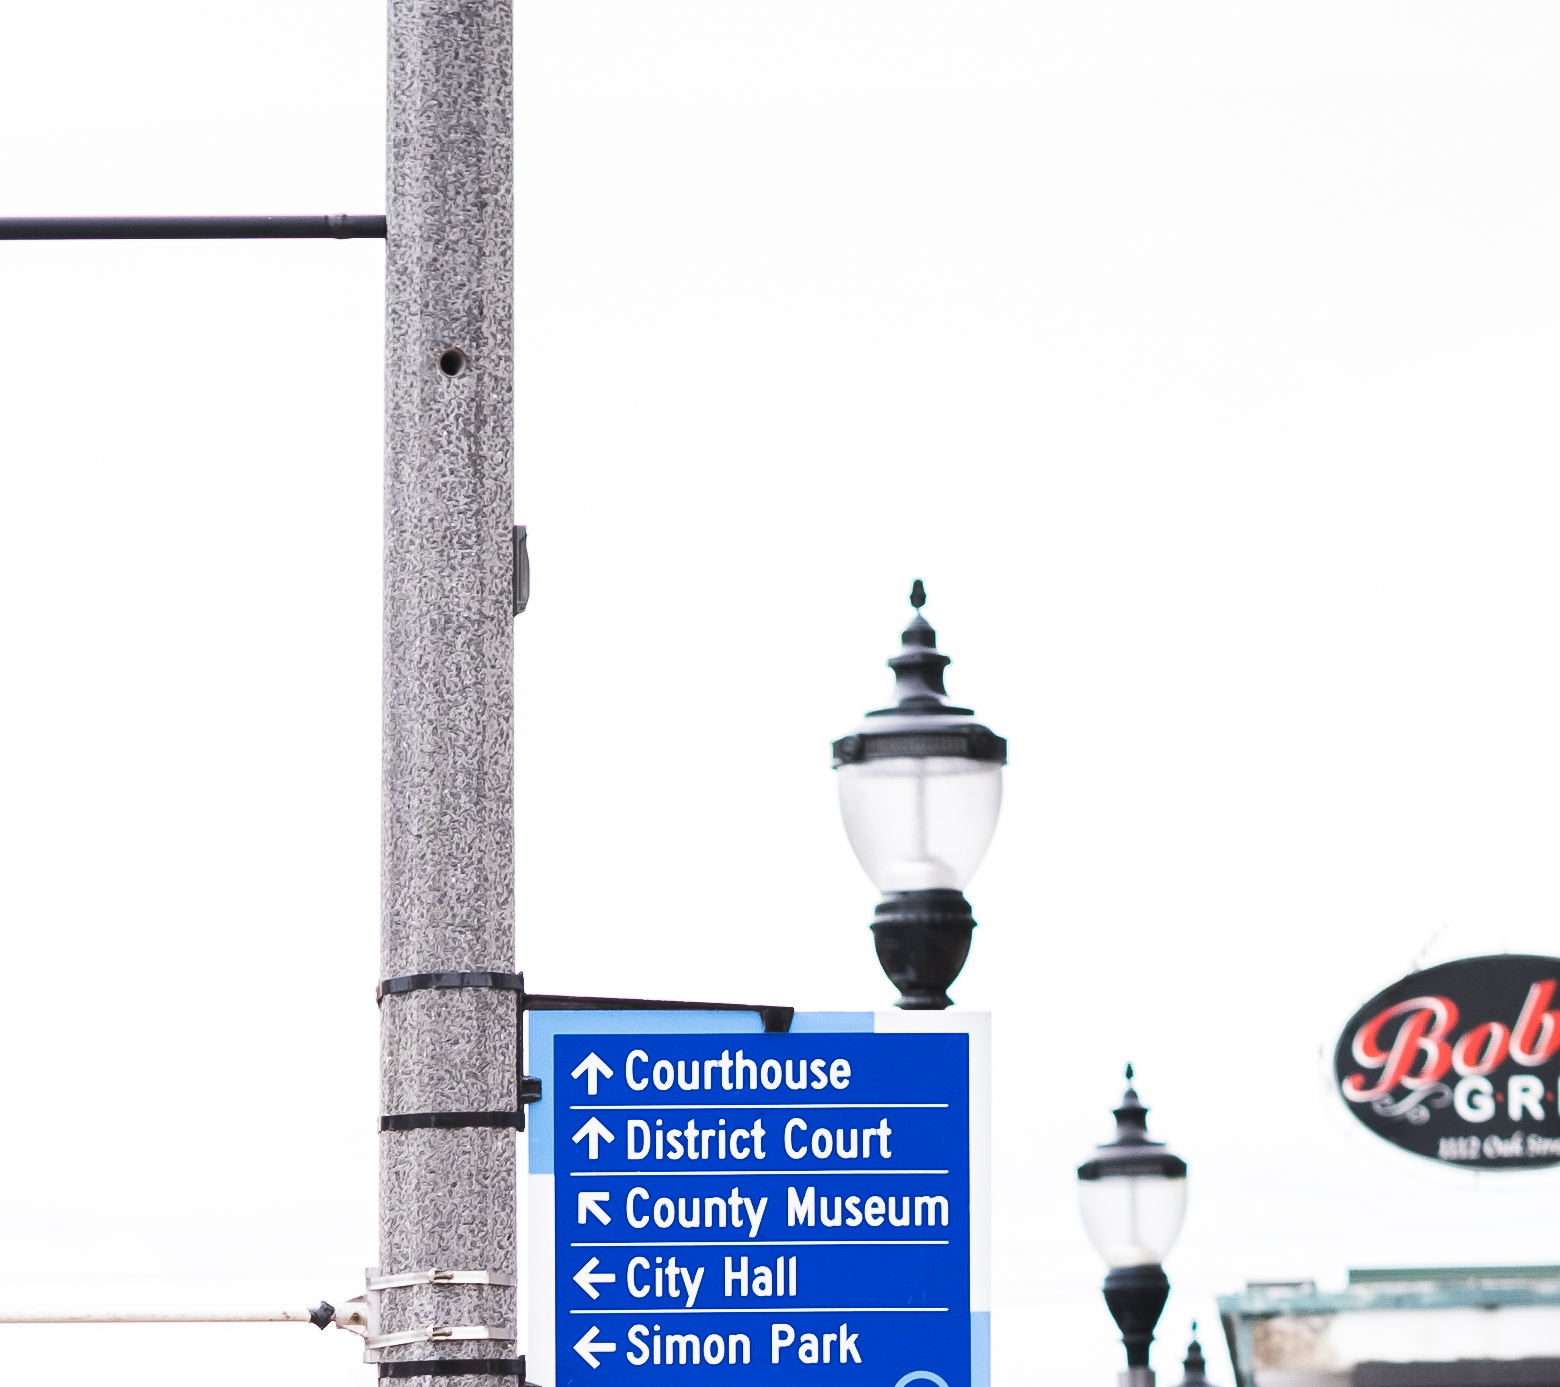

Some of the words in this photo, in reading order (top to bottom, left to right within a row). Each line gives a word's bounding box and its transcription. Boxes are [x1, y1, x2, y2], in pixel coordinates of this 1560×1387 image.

[626, 1050, 851, 1091] Courthouse
[627, 1119, 766, 1160] District
[784, 1118, 892, 1160] Court
[626, 1187, 768, 1238] County
[787, 1187, 949, 1228] Museum
[626, 1257, 705, 1307] City
[724, 1256, 797, 1297] Hall
[626, 1324, 751, 1365] Simon
[771, 1323, 863, 1364] Park
